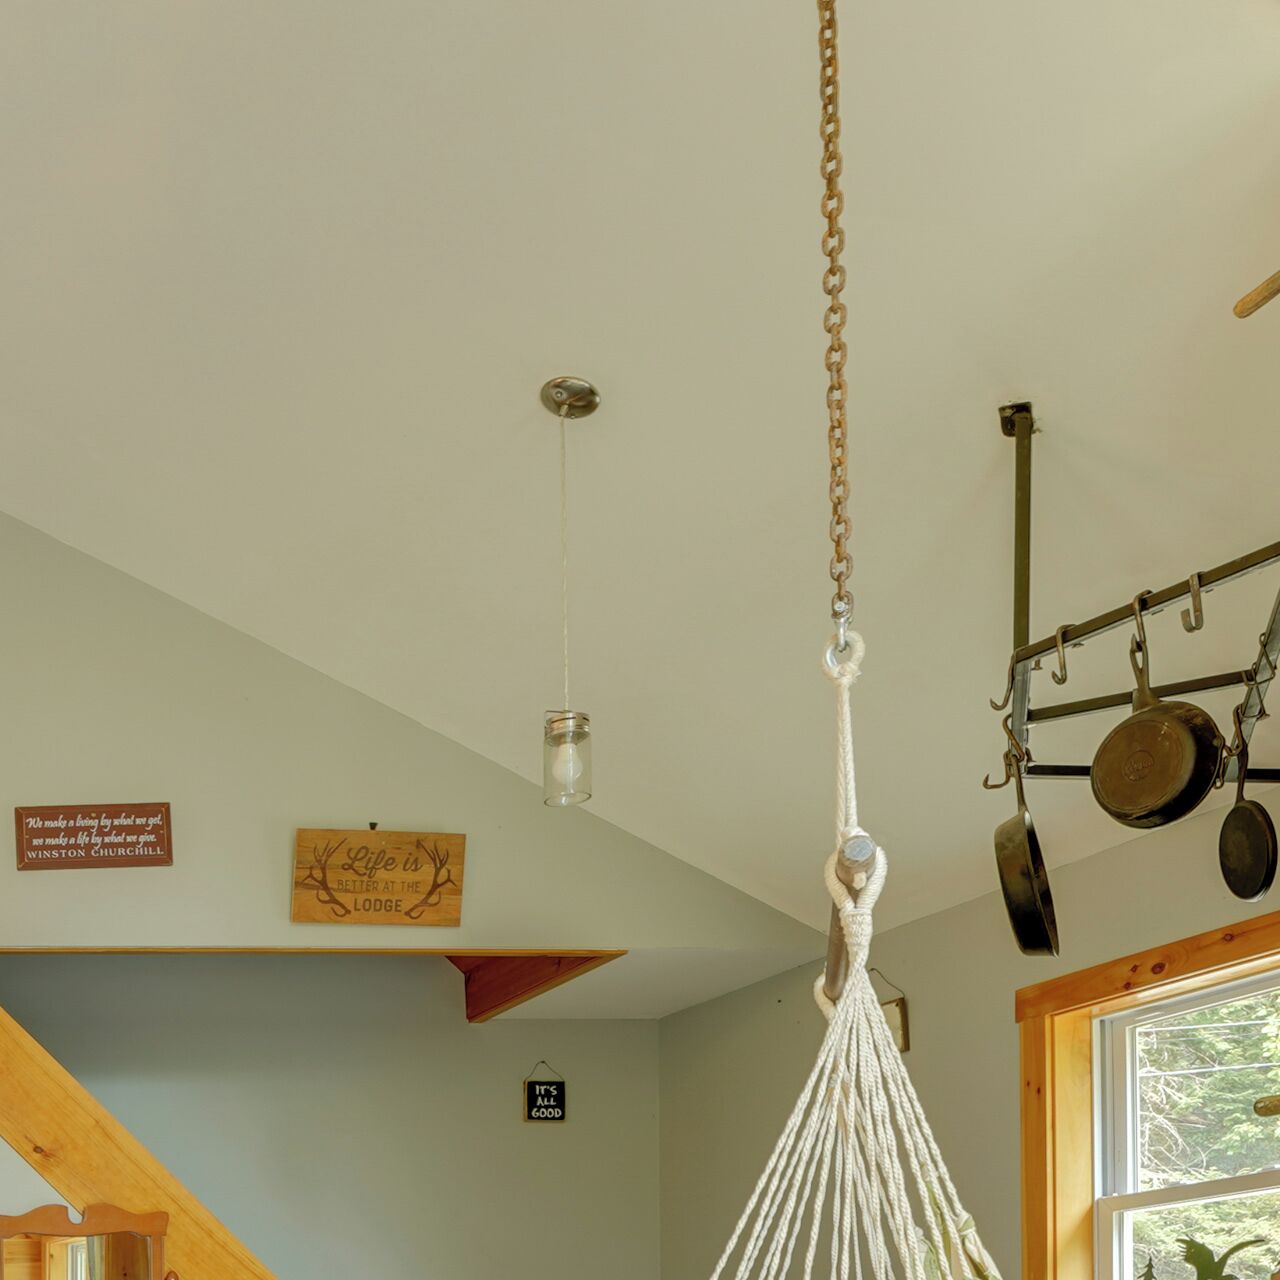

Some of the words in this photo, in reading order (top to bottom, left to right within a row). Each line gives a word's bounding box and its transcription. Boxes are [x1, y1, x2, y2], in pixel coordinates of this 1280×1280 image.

[26, 817, 42, 829] We
[44, 814, 67, 829] make
[75, 814, 99, 832] living
[100, 813, 111, 832] by
[113, 812, 135, 826] what
[32, 837, 44, 846] we
[45, 832, 67, 846] make
[76, 831, 89, 847] life
[91, 830, 102, 849] by
[104, 830, 126, 843] what
[26, 848, 86, 859] WINSTON
[90, 846, 165, 857] CHURCHILL
[341, 845, 399, 879] Life
[402, 852, 424, 873] is
[337, 879, 380, 893] BETTER
[383, 880, 396, 893] AT
[401, 880, 422, 893] THE
[353, 898, 403, 913] LODGE
[535, 1084, 558, 1096] IT'S
[536, 1096, 557, 1107] ALL
[531, 1107, 563, 1118] GOOD
